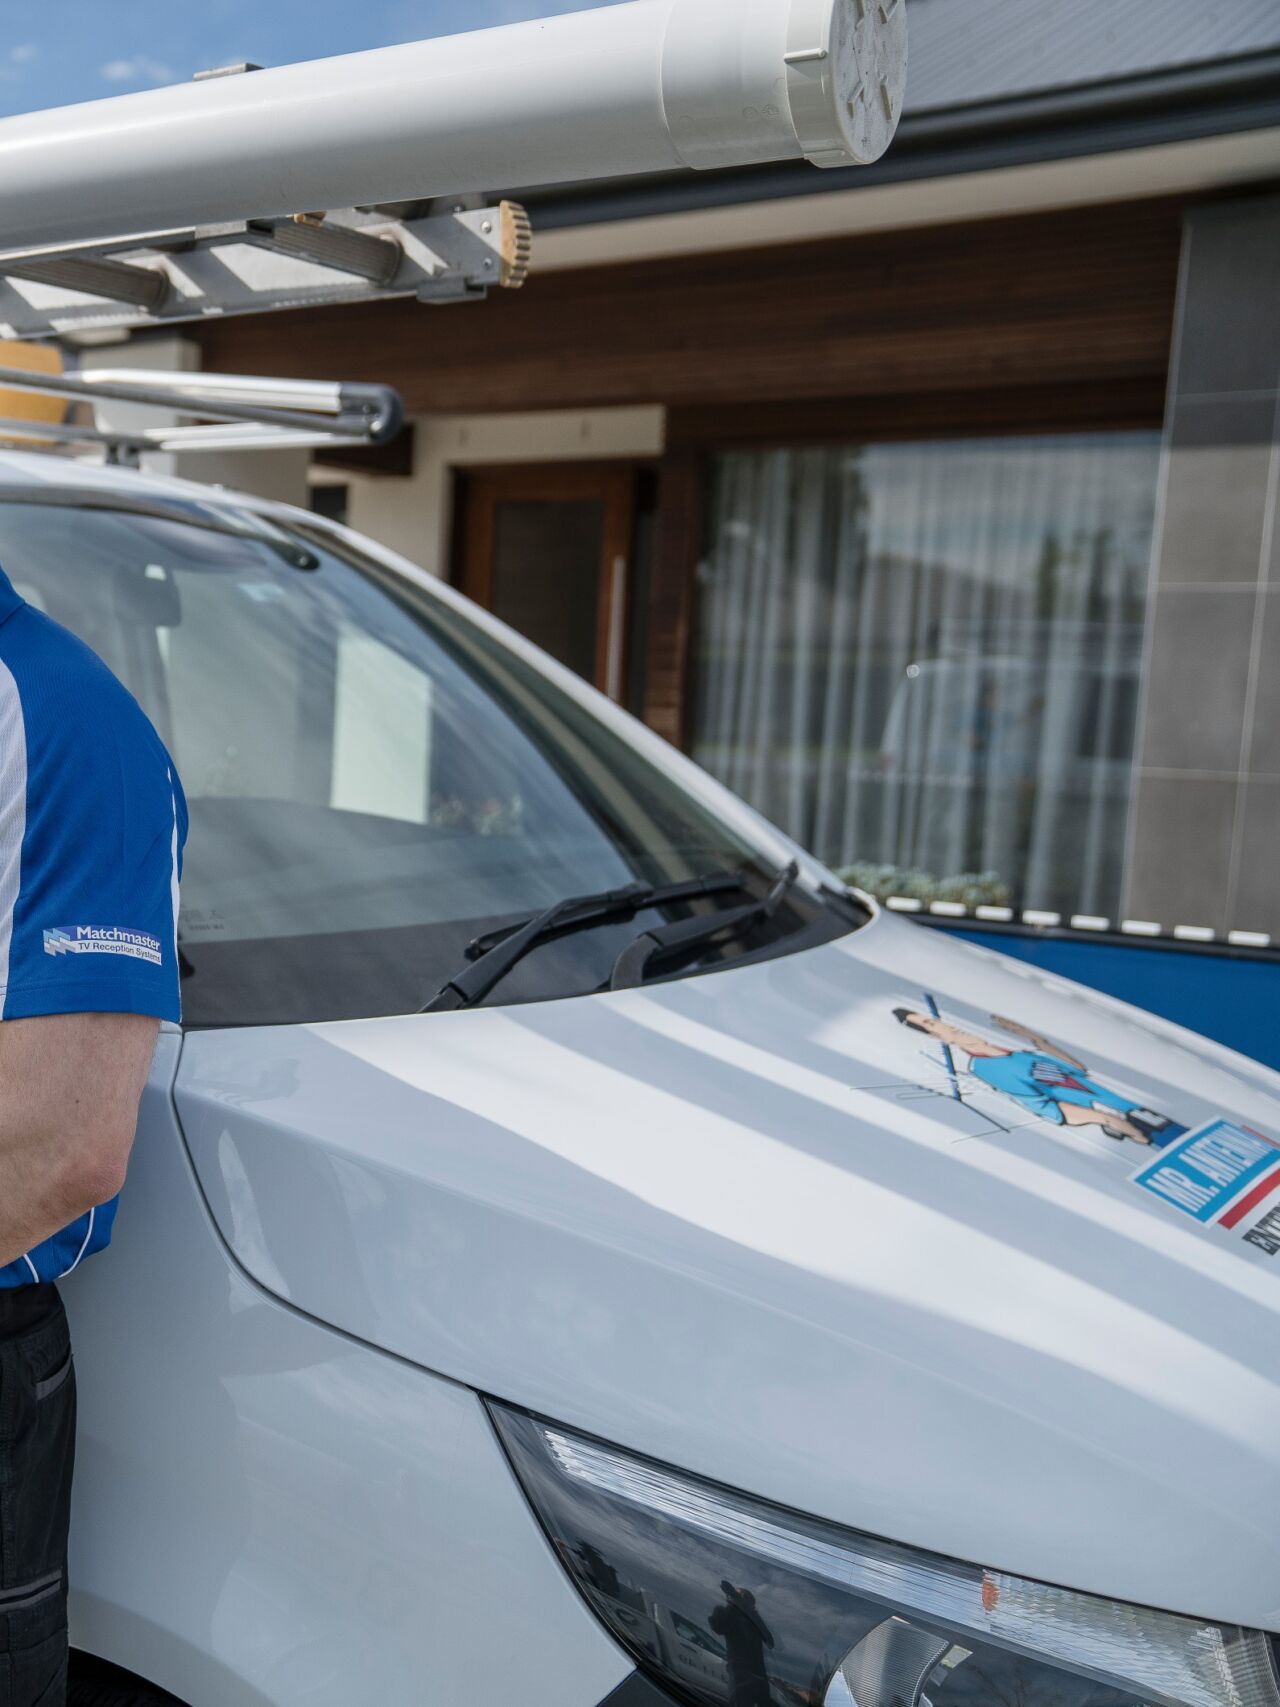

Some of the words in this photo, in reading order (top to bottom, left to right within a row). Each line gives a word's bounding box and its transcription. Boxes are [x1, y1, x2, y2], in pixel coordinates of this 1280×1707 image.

[77, 926, 160, 951] Matchmaster
[78, 942, 90, 950] TV
[93, 942, 134, 954] Reception
[136, 947, 160, 962] Systems
[1146, 1166, 1220, 1213] MR.
